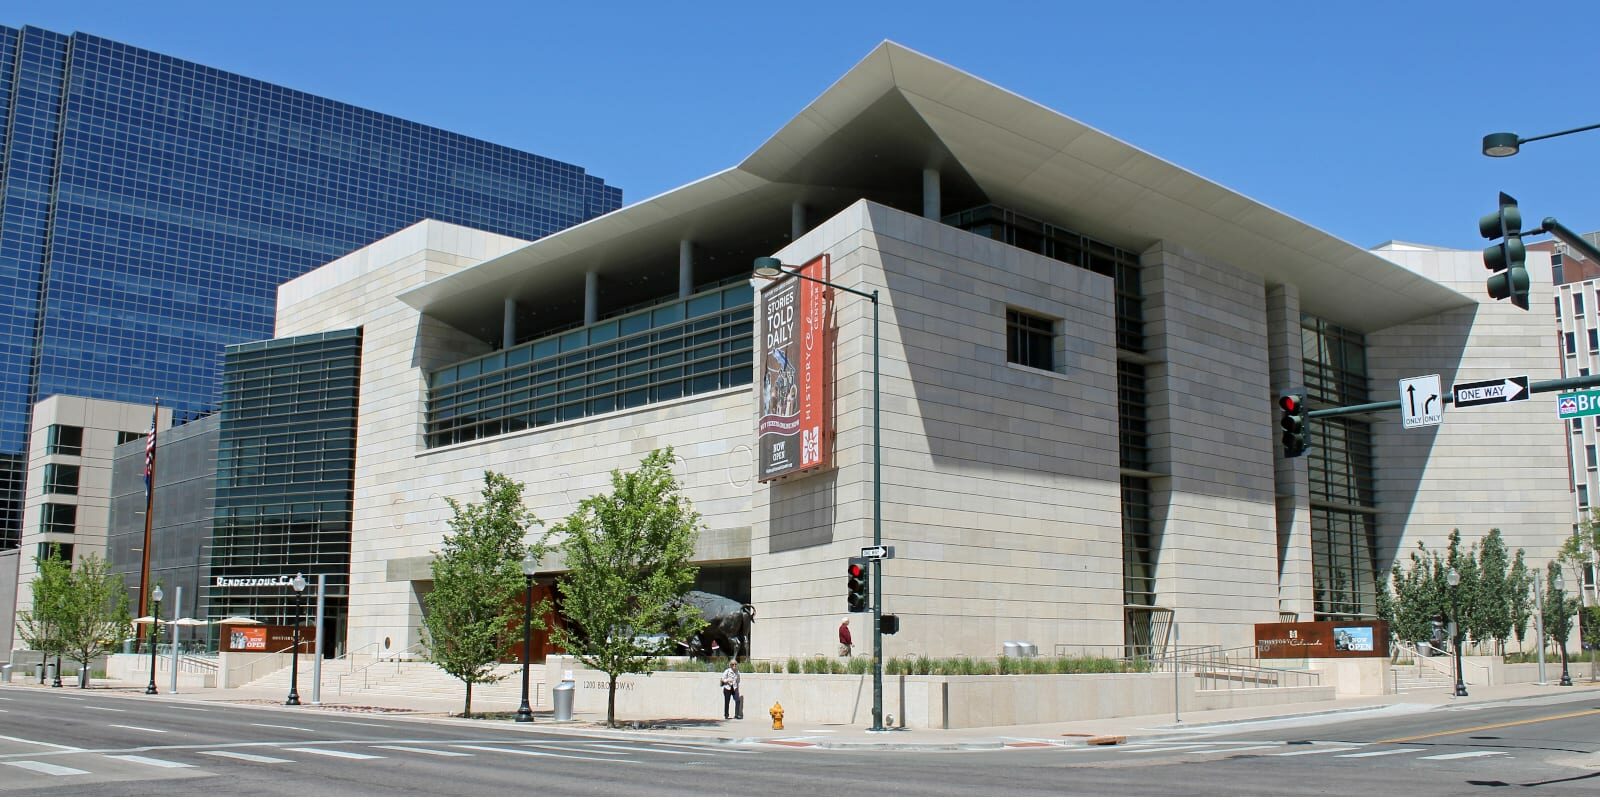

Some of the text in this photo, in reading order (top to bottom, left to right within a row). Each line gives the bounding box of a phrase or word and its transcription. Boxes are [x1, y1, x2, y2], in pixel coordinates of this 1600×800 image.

[767, 291, 794, 315] STORIES
[767, 305, 794, 332] TOLD
[767, 322, 794, 349] DAILY
[1461, 386, 1504, 400] ONE WAY
[1578, 394, 1600, 411] Br
[1406, 417, 1422, 425] ONLY
[773, 440, 786, 453] NOW
[772, 450, 785, 461] OPEN
[583, 680, 635, 691] 1200 BRODWAY
